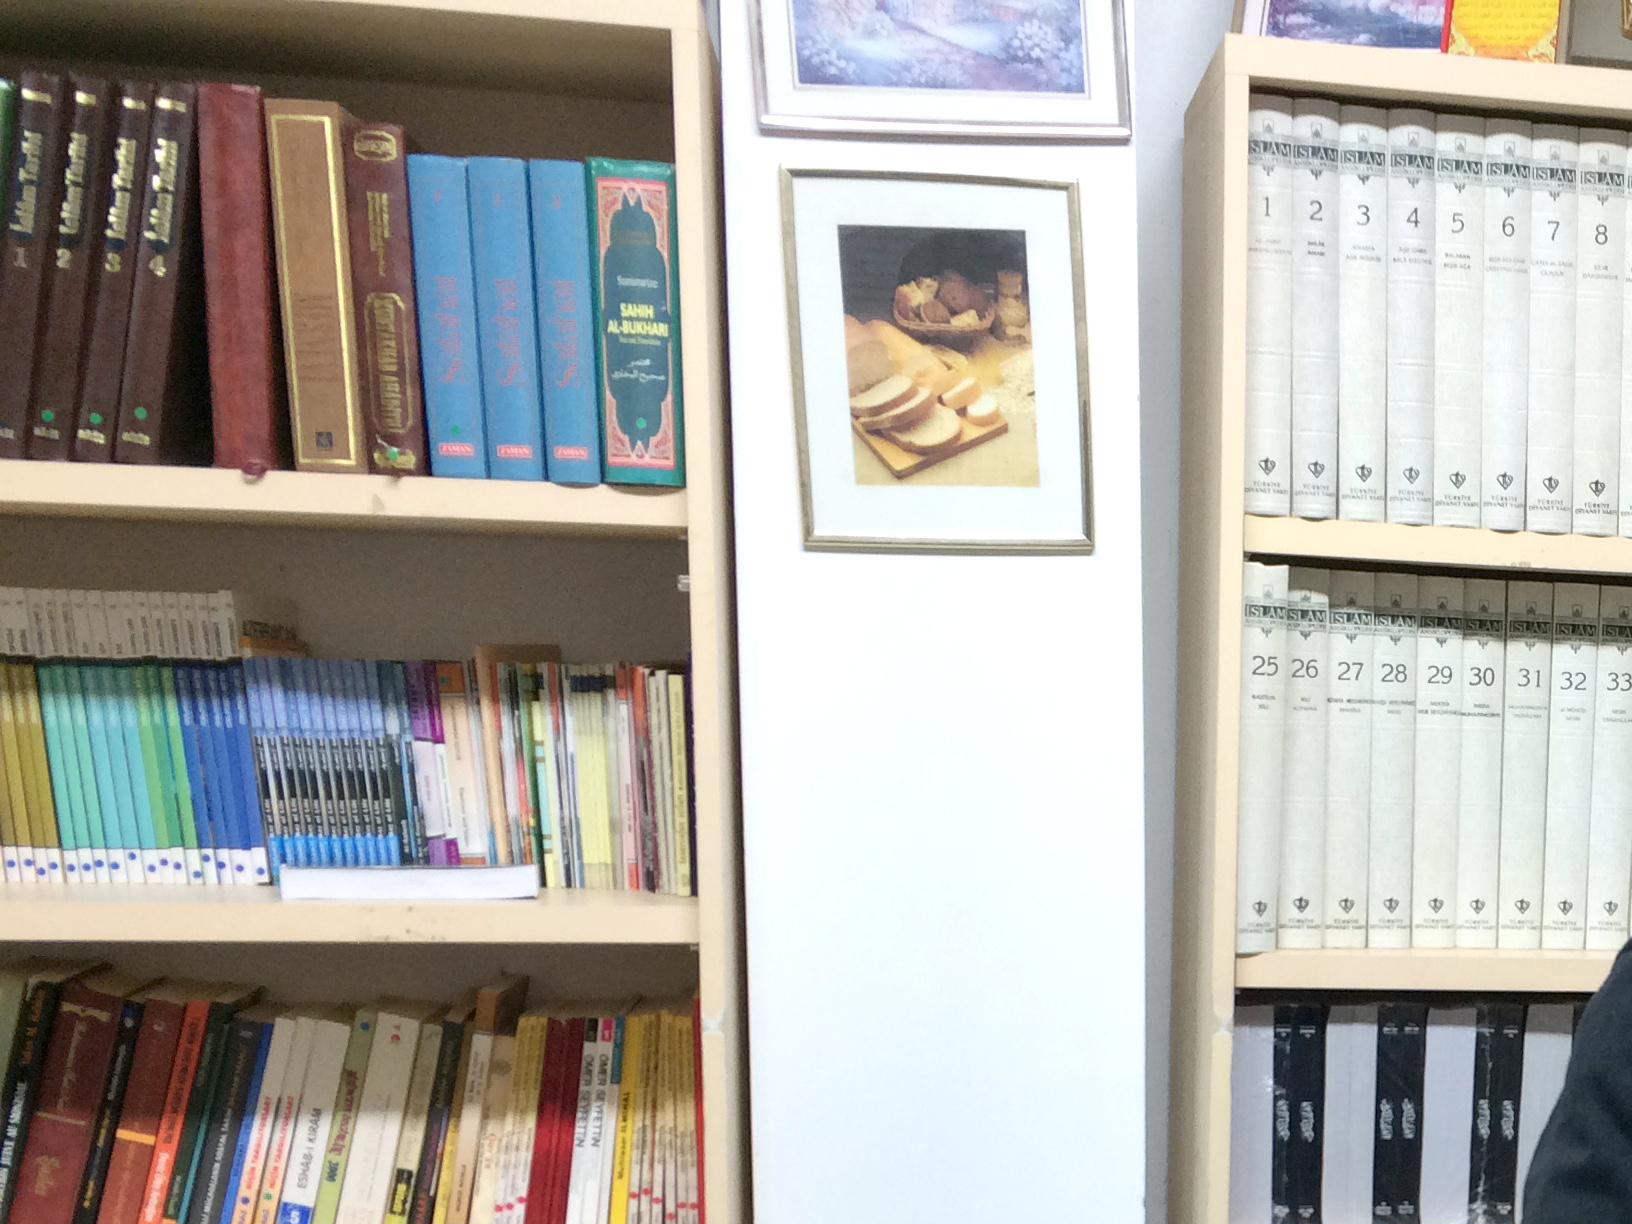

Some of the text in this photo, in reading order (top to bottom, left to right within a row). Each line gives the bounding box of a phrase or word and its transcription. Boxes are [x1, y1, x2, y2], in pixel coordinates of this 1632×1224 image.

[1263, 196, 1271, 217] 1
[1309, 200, 1323, 221] 2
[1357, 205, 1370, 226] 3
[1406, 207, 1420, 228] 4
[1451, 212, 1465, 234] 5
[1502, 216, 1515, 237] 6
[1547, 221, 1560, 241] 7
[1595, 224, 1608, 245] 8
[13, 247, 27, 268] 1
[56, 249, 72, 269] 2
[105, 252, 121, 272] 3
[149, 254, 167, 278] 4
[620, 303, 654, 319] SAHIH
[607, 320, 669, 338] AL-BUKHARI
[1252, 655, 1278, 676] 25
[1291, 659, 1318, 679] 26
[1337, 661, 1364, 681] 27
[1381, 664, 1407, 683] 28
[1427, 665, 1453, 685] 29
[1469, 667, 1495, 687] 30
[1518, 668, 1541, 688] 31
[1560, 671, 1587, 690] 32
[1607, 672, 1632, 691] 33
